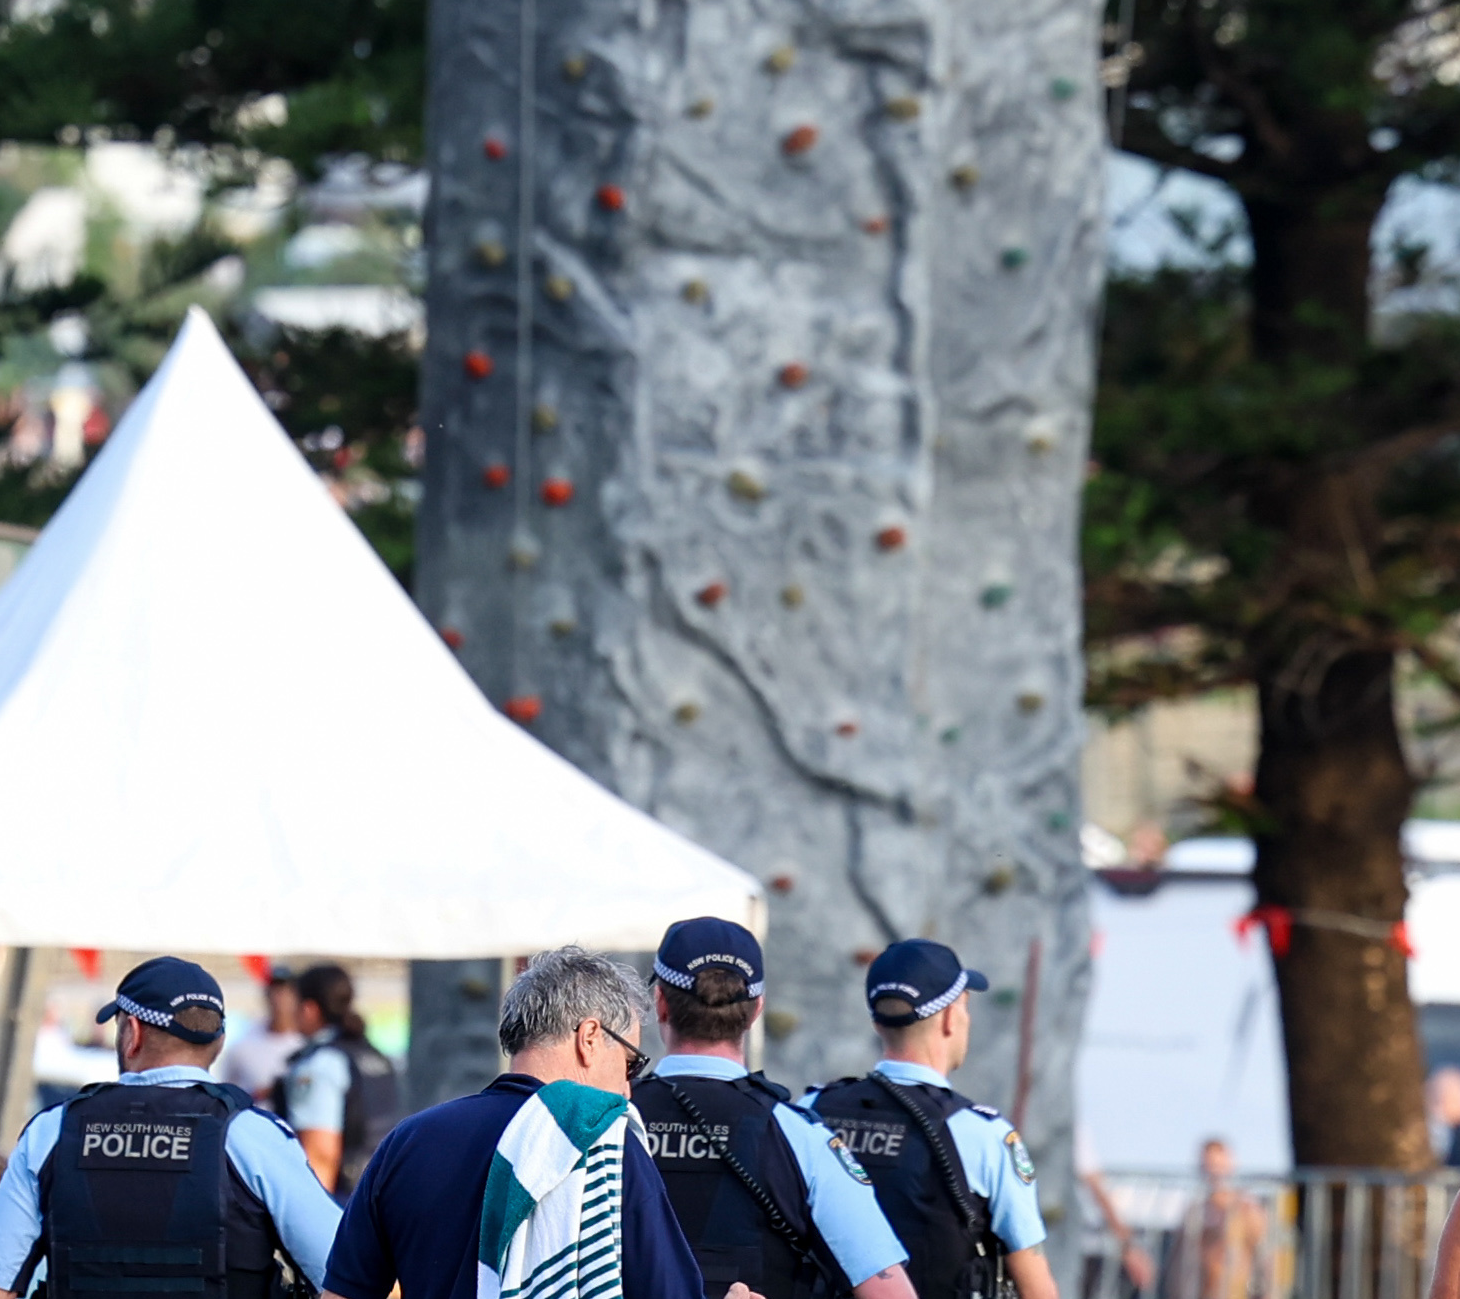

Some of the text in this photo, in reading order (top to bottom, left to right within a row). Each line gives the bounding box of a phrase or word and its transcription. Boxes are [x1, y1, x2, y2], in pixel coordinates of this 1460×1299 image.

[705, 953, 735, 964] POLICE
[85, 1123, 192, 1137] NEW SOUTH WALES
[648, 1122, 688, 1133] SOUTH
[82, 1133, 191, 1160] POLICE
[646, 1133, 729, 1159] OLICE
[833, 1128, 905, 1157] OLICE
